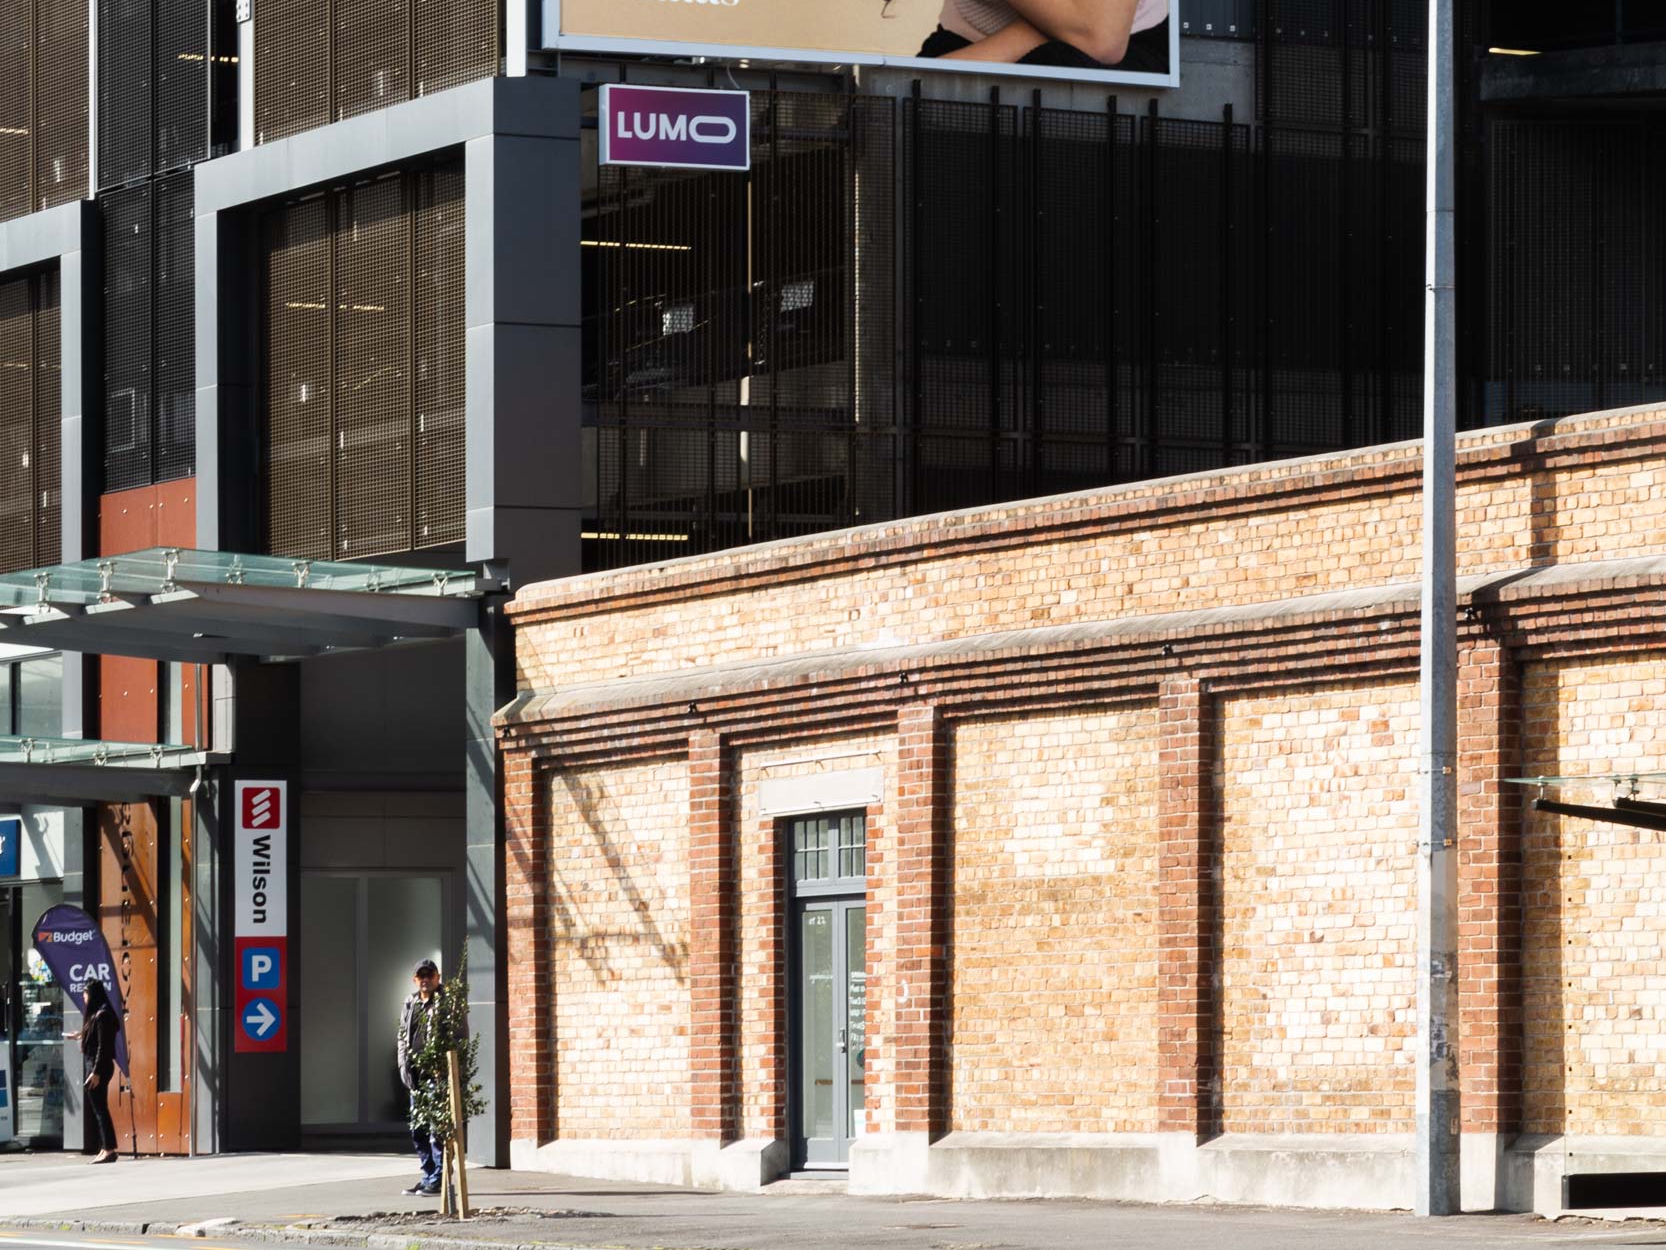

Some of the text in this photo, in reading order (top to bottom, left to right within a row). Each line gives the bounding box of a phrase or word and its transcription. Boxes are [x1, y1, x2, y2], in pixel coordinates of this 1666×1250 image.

[616, 111, 738, 145] LUMO
[252, 834, 272, 924] Wilson
[53, 930, 94, 946] Budget
[69, 962, 111, 982] CAR
[251, 955, 272, 983] P
[70, 981, 112, 993] REN
